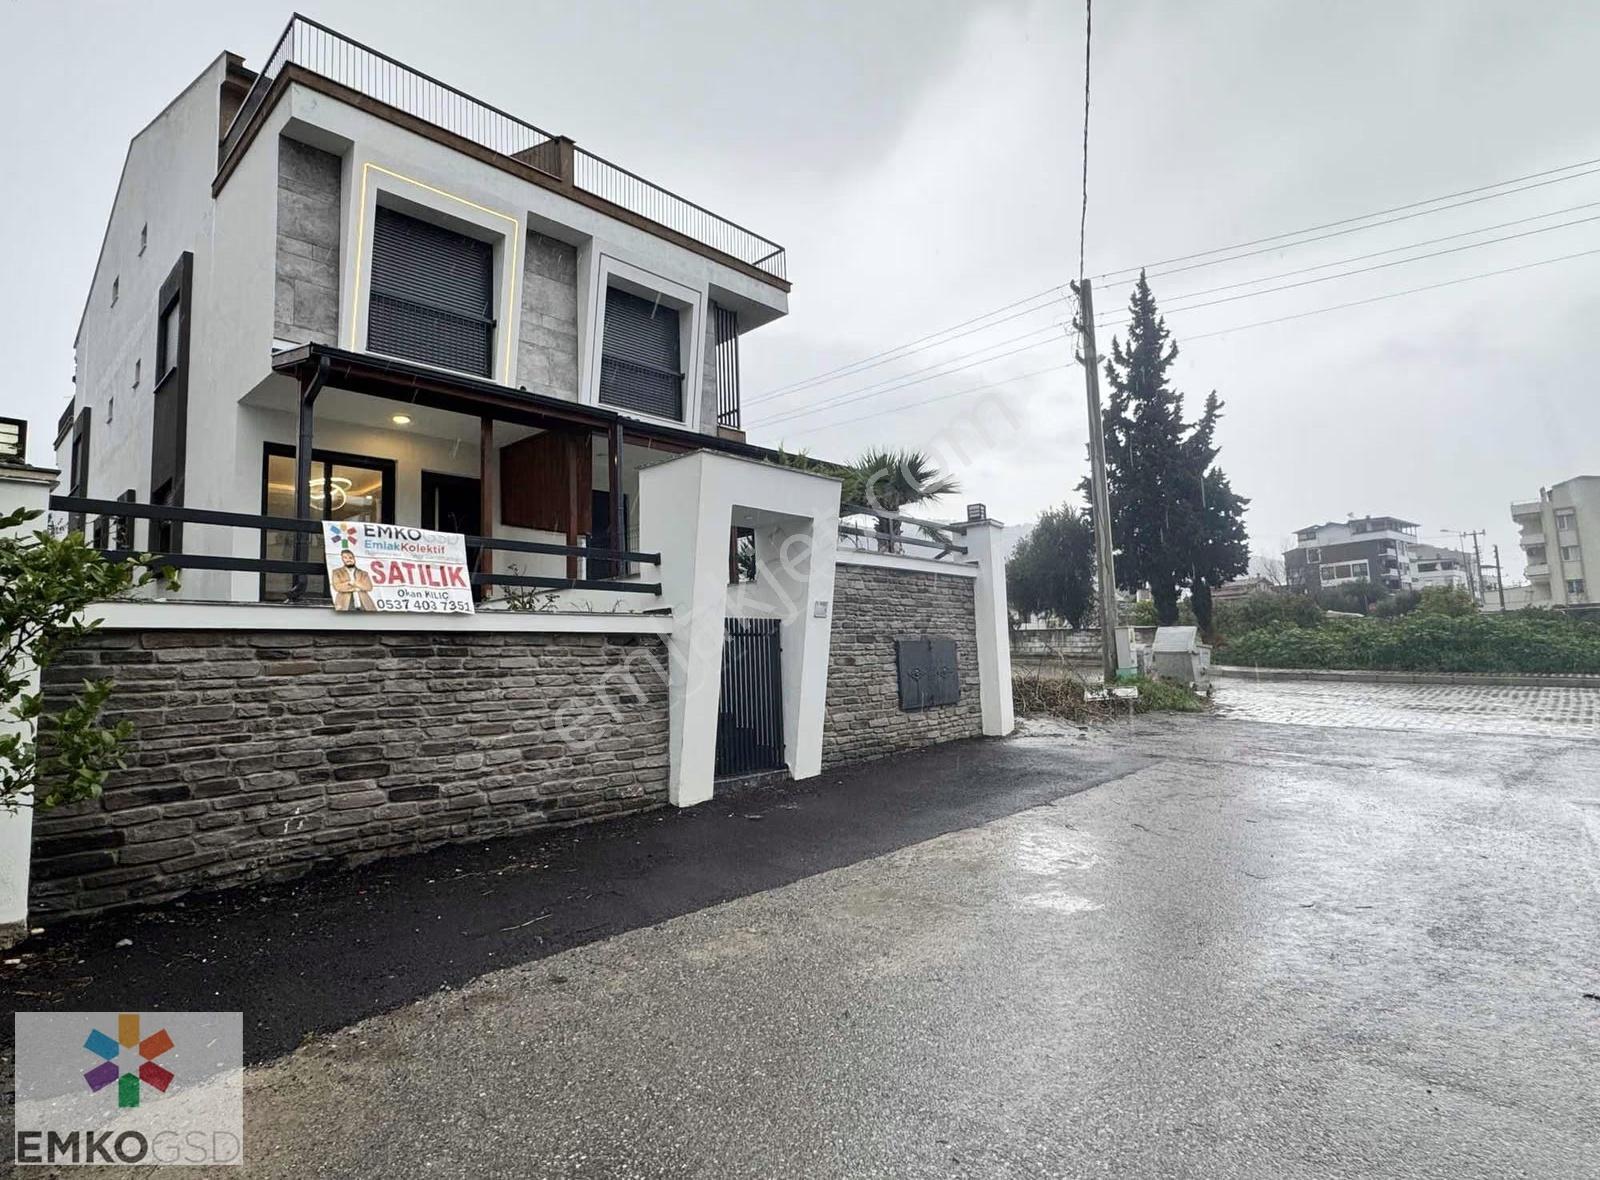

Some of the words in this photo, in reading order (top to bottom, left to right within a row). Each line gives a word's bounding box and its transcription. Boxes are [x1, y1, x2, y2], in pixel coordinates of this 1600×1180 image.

[370, 560, 467, 588] SATILIK
[377, 599, 409, 610] 0537
[413, 600, 437, 611] 403
[441, 600, 470, 612] 7351
